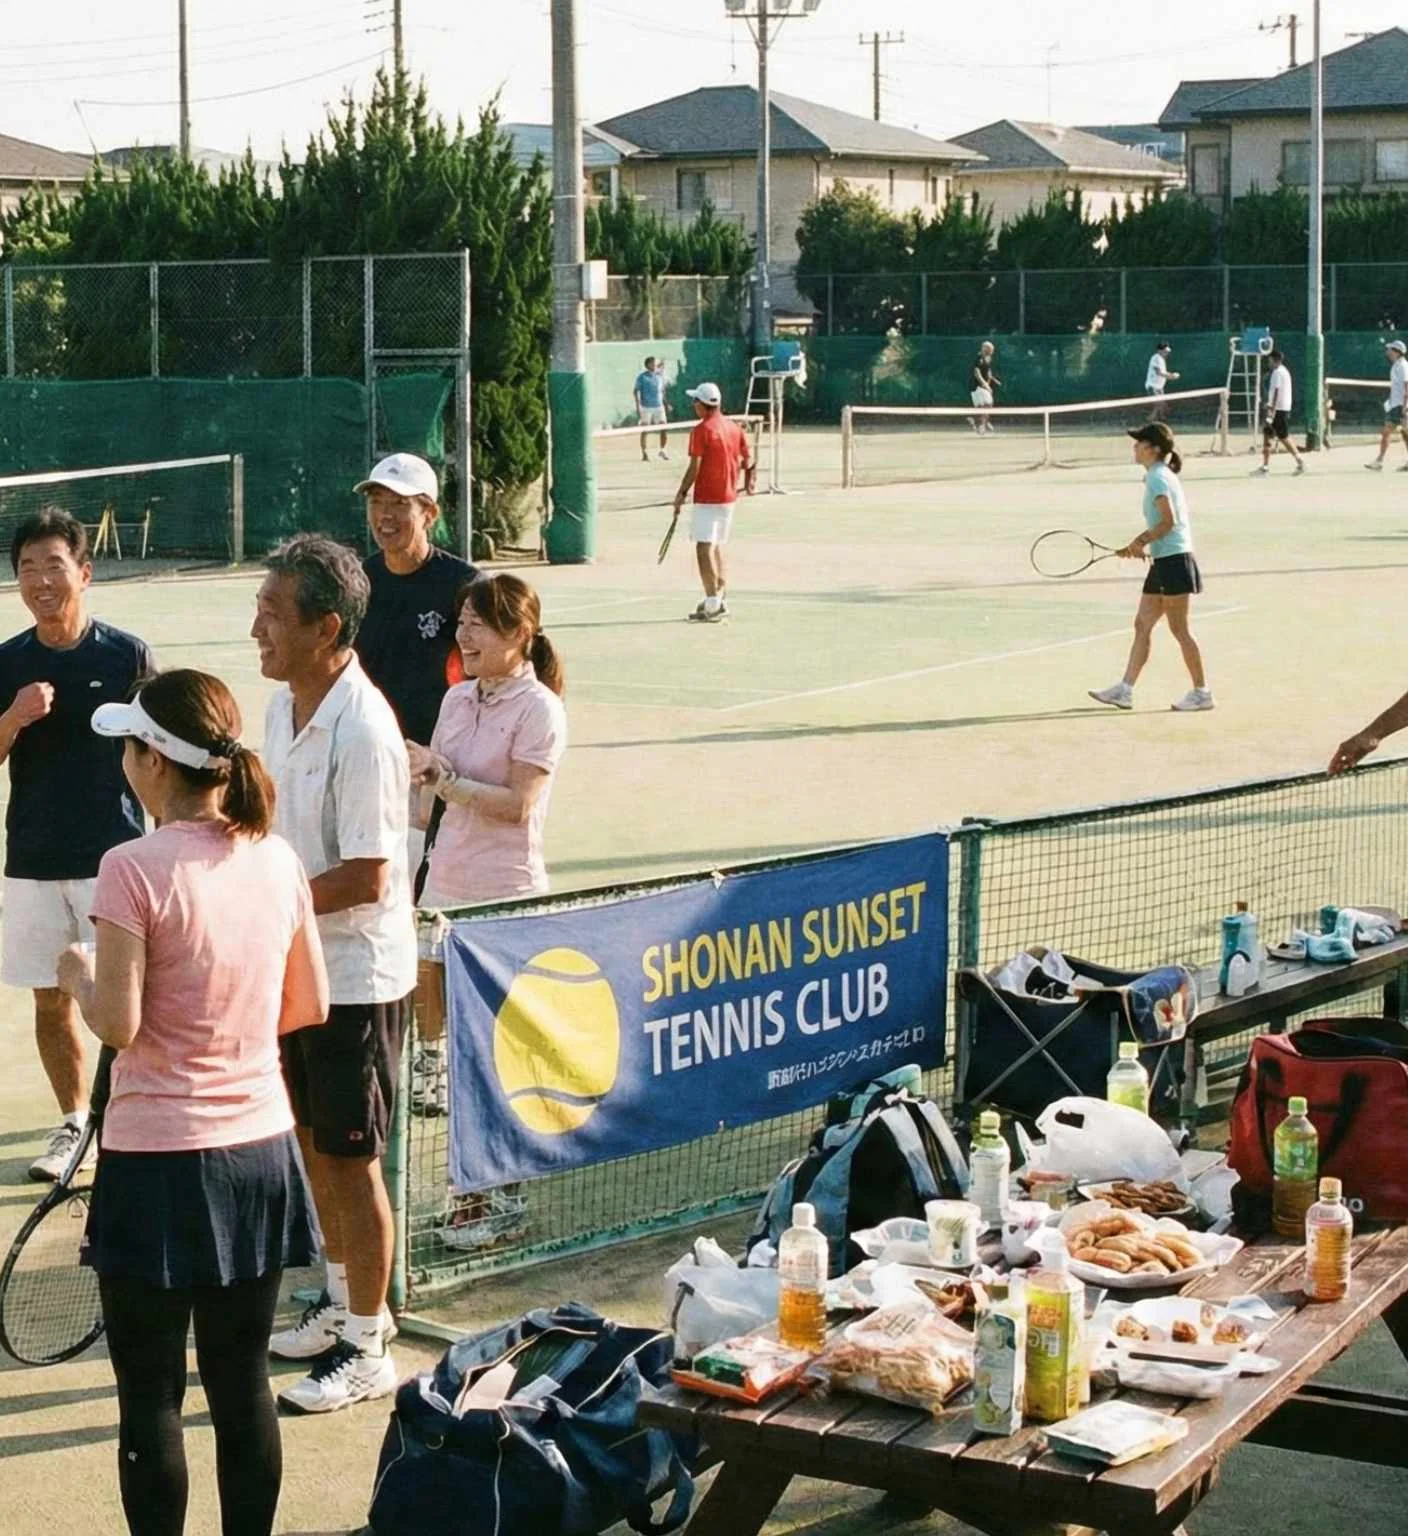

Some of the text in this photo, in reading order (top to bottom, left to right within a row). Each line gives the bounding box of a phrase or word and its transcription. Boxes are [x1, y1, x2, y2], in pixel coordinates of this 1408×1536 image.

[642, 881, 927, 1003] SHONAN SUNSET
[643, 990, 786, 1076] TENNIS
[796, 962, 890, 1035] CLUB
